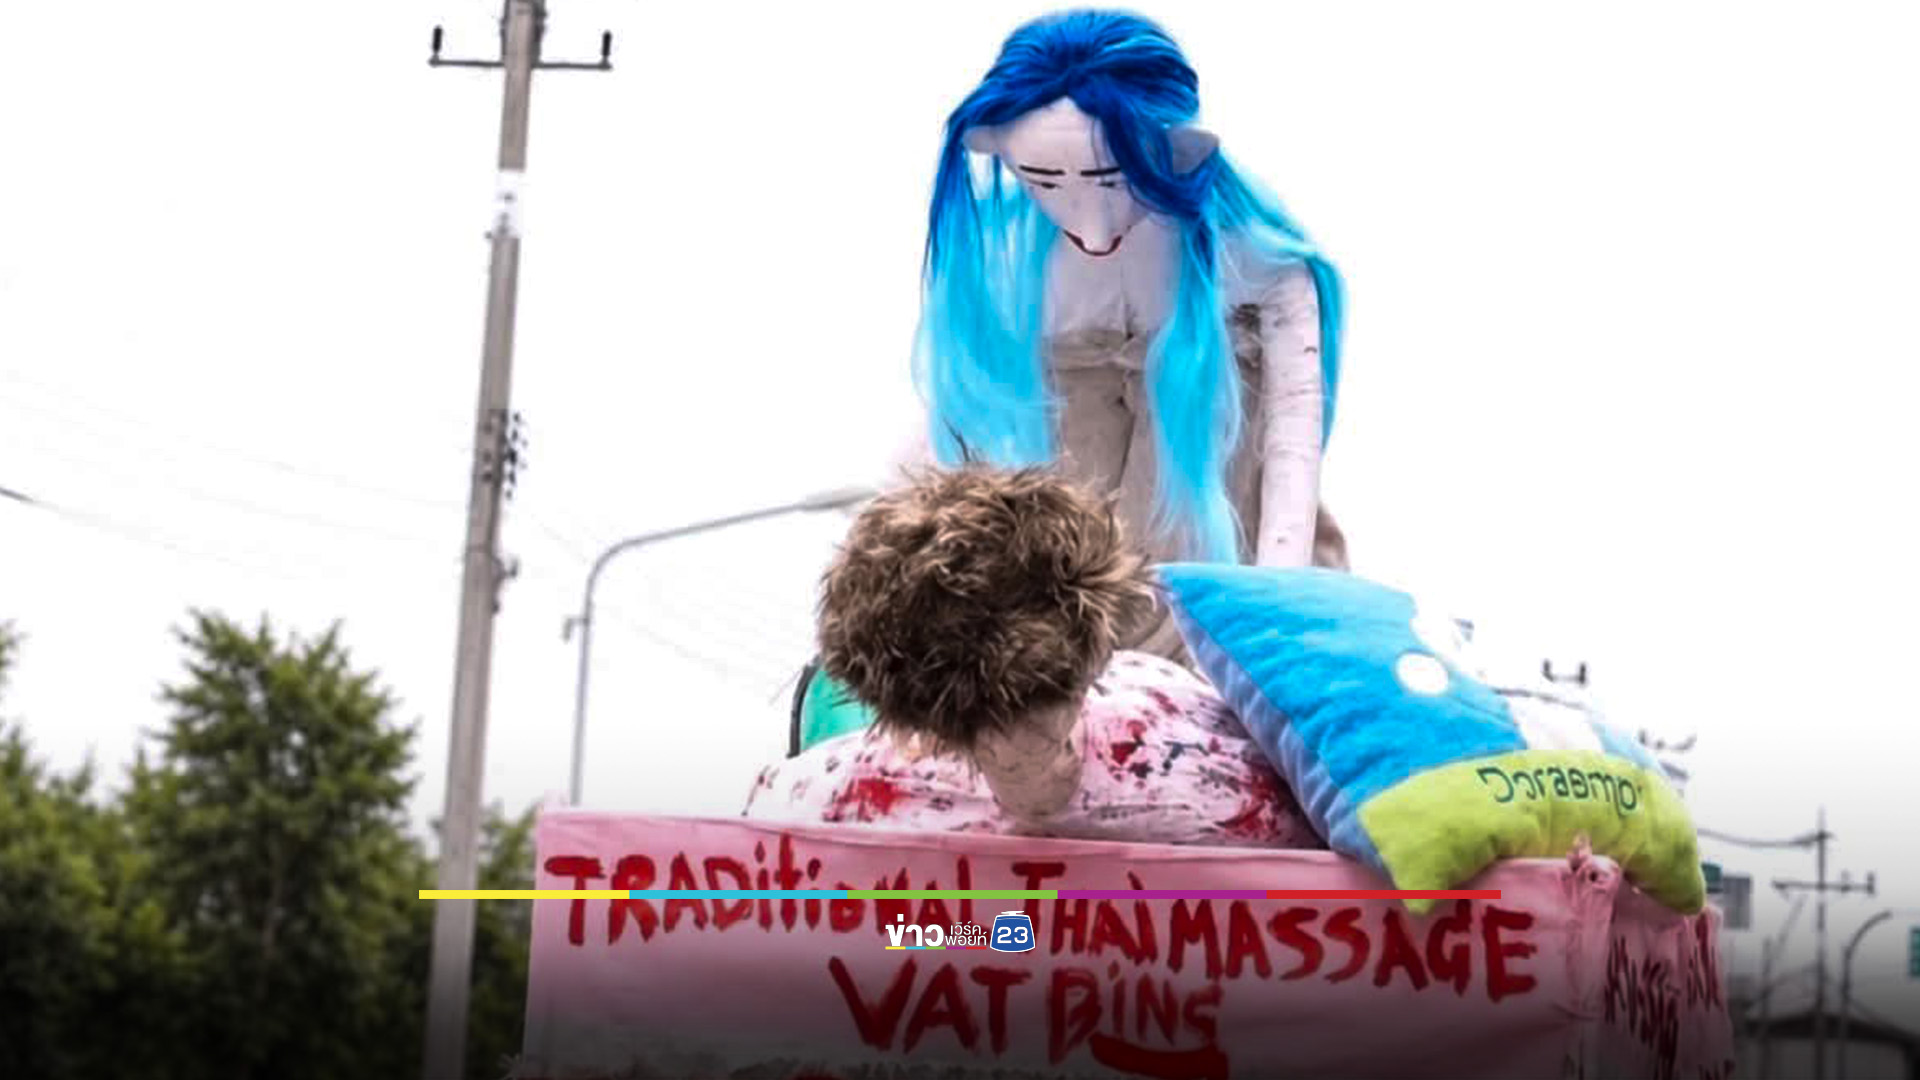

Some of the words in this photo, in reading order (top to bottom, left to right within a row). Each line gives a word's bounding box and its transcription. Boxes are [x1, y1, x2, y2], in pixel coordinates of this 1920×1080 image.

[1476, 766, 1643, 819] Doraemo
[1168, 898, 1538, 1003] MASSAGE
[828, 955, 1032, 1054] VAT
